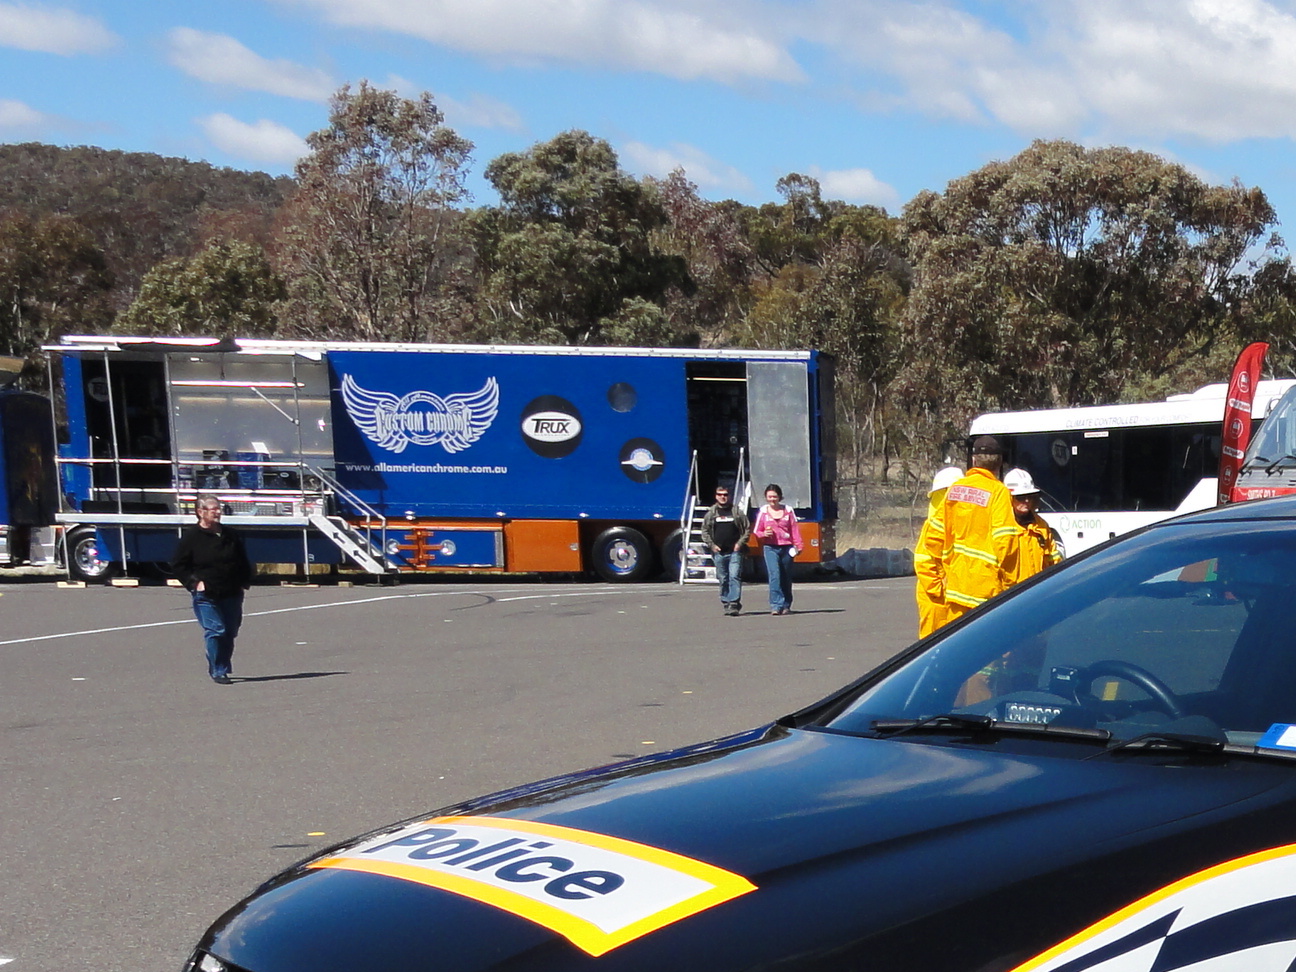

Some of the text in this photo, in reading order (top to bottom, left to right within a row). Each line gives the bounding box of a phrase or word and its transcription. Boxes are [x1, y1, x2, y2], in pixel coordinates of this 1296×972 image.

[374, 405, 425, 441] CUSTOM
[531, 418, 571, 434] TRUX
[1094, 416, 1139, 427] CONTROLLED
[345, 462, 508, 475] www.allamericanchrome.com.au
[1071, 520, 1102, 530] ACTION
[361, 828, 625, 900] Police
